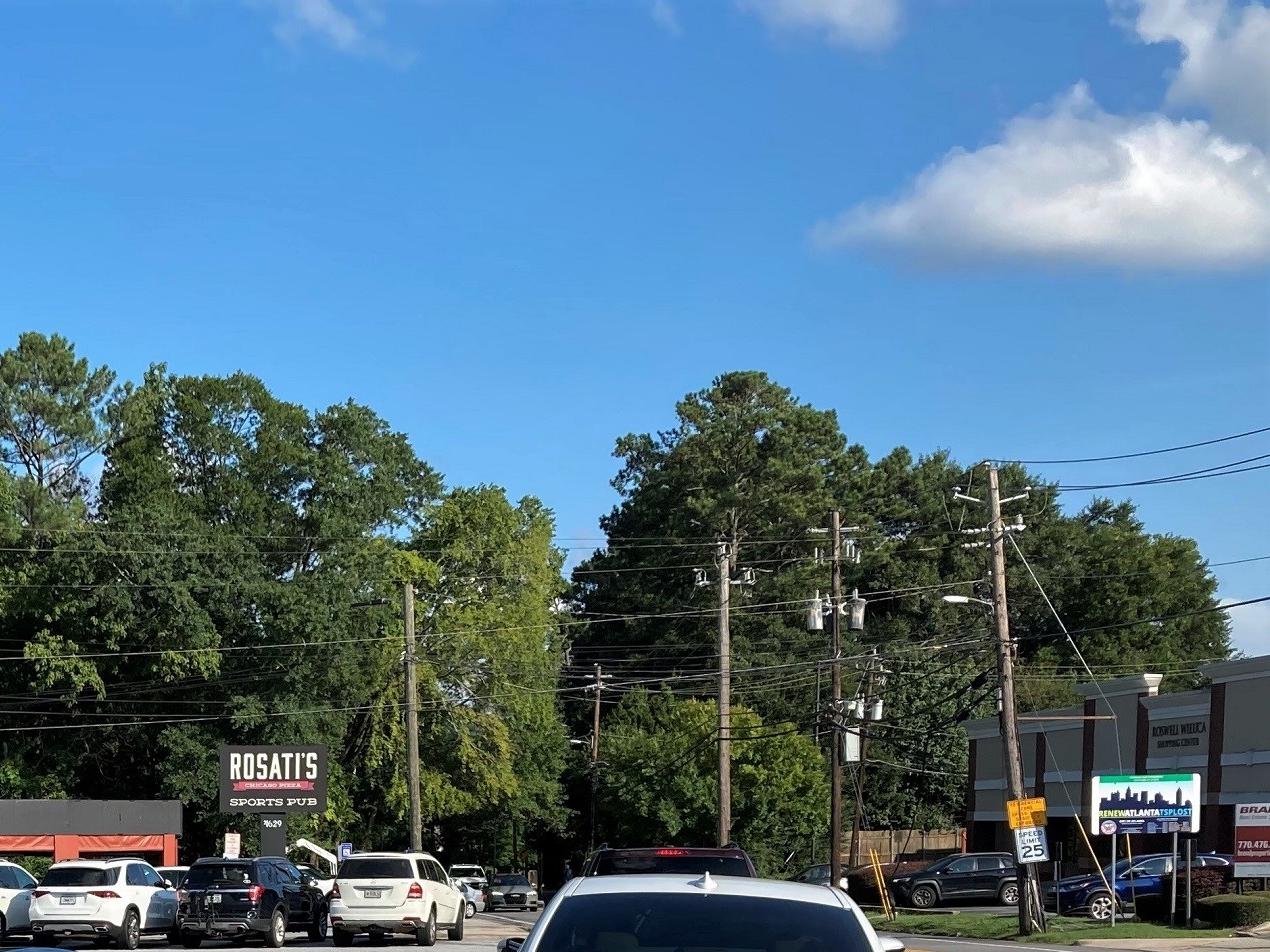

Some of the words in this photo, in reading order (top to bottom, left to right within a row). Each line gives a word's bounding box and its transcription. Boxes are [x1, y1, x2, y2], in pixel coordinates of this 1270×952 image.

[230, 752, 318, 780] ROSATI'S
[230, 798, 283, 806] SPORTS
[287, 798, 318, 806] PUB
[1240, 806, 1270, 814] BRA
[1018, 830, 1043, 838] SPEED
[1021, 837, 1042, 845] LIMIT
[1022, 844, 1045, 858] 25
